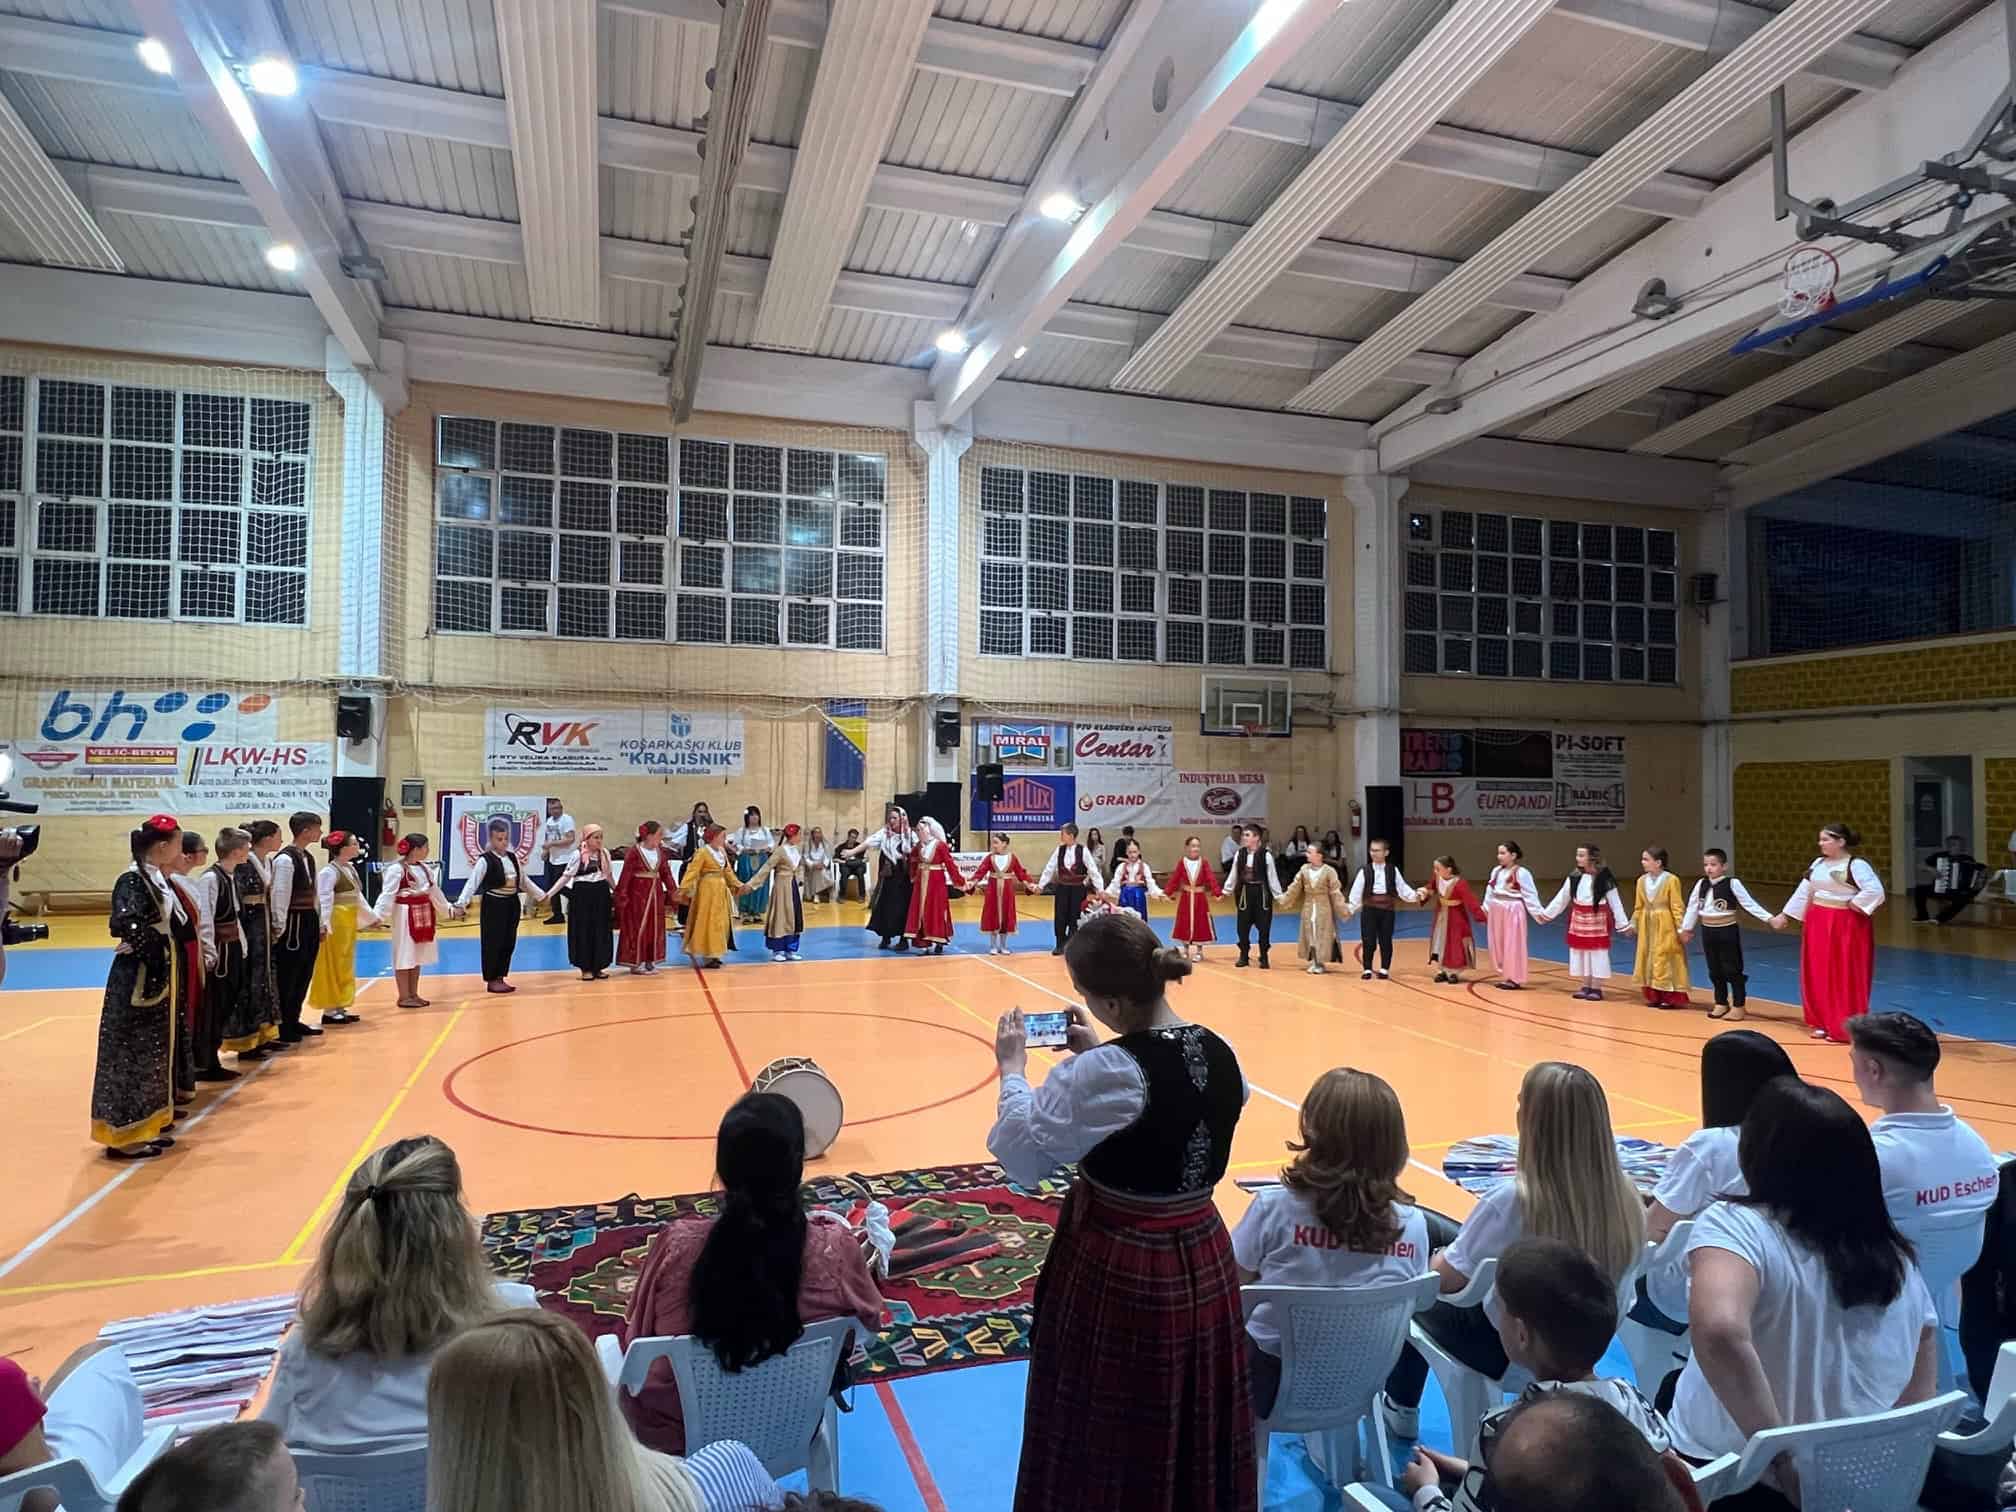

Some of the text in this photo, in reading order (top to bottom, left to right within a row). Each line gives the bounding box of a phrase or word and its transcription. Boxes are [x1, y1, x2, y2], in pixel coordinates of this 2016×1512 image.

[41, 689, 148, 741] bh
[507, 721, 600, 746] RVK
[995, 735, 1048, 746] MIRAL
[1555, 734, 1626, 751] PI-SOFT
[708, 740, 742, 751] KLUB
[1075, 732, 1156, 758] Centar
[203, 746, 308, 765] LKW-HS
[236, 766, 279, 775] CAZIN
[1178, 773, 1238, 784] INDUSTRIJA
[1095, 795, 1146, 806] GRAND
[1916, 1186, 1951, 1207] KUD
[1294, 1224, 1340, 1250] KUD
